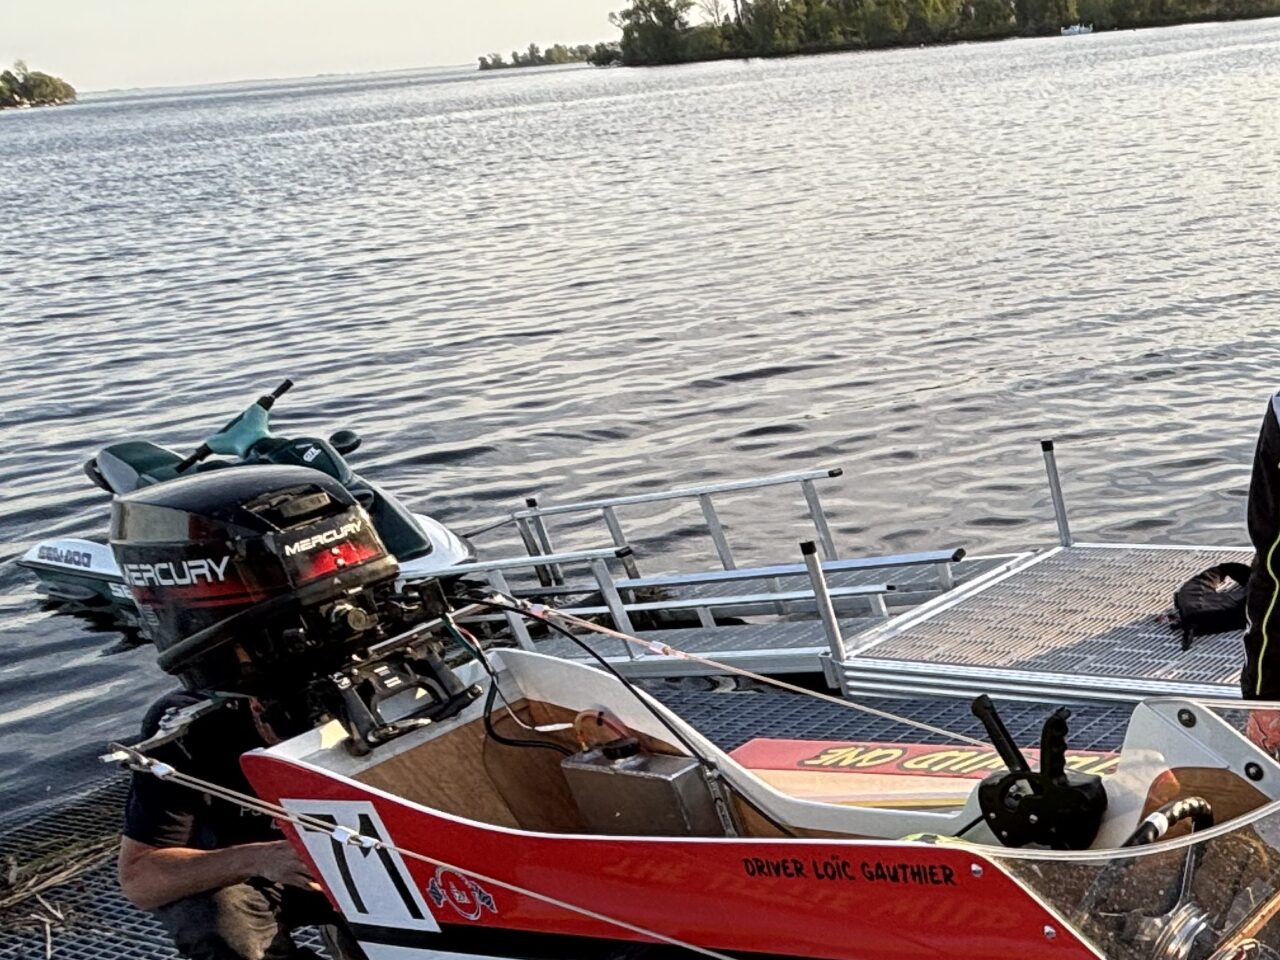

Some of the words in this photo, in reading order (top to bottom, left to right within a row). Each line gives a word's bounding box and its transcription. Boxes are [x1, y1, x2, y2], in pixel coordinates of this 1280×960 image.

[284, 520, 362, 556] MERCURY
[801, 746, 905, 769] ONE
[298, 813, 425, 920] 71
[742, 857, 807, 879] DRIVER
[812, 854, 855, 880] LOÏC
[860, 861, 957, 886] GAUTHIER
